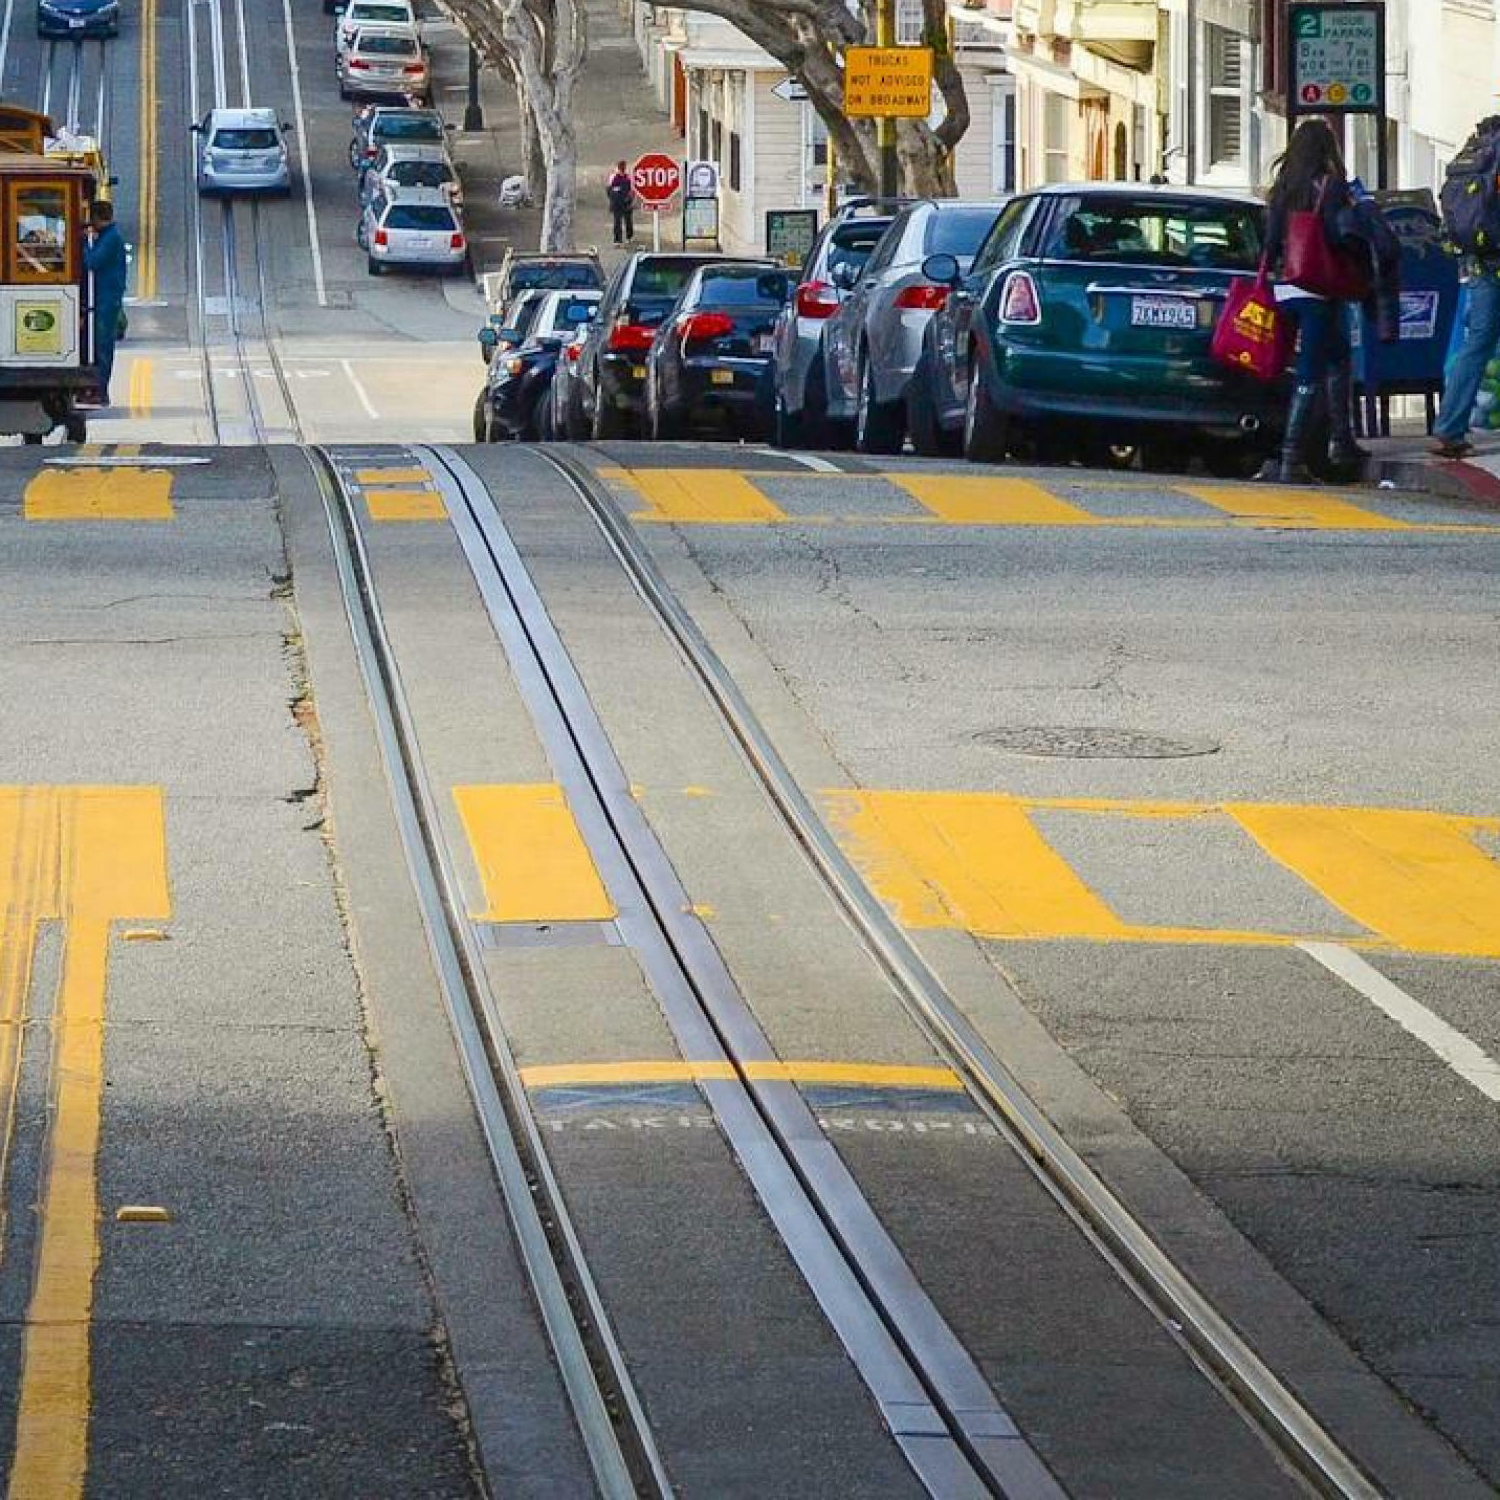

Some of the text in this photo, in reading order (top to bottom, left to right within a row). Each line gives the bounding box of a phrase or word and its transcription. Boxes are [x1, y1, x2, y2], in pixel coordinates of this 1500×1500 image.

[1301, 14, 1317, 35] 2
[1324, 28, 1373, 38] PARKING
[869, 55, 908, 66] TRUCKS
[850, 75, 924, 86] NOT ADVISED
[870, 94, 927, 105] BROADWAY
[636, 167, 678, 188] STOP
